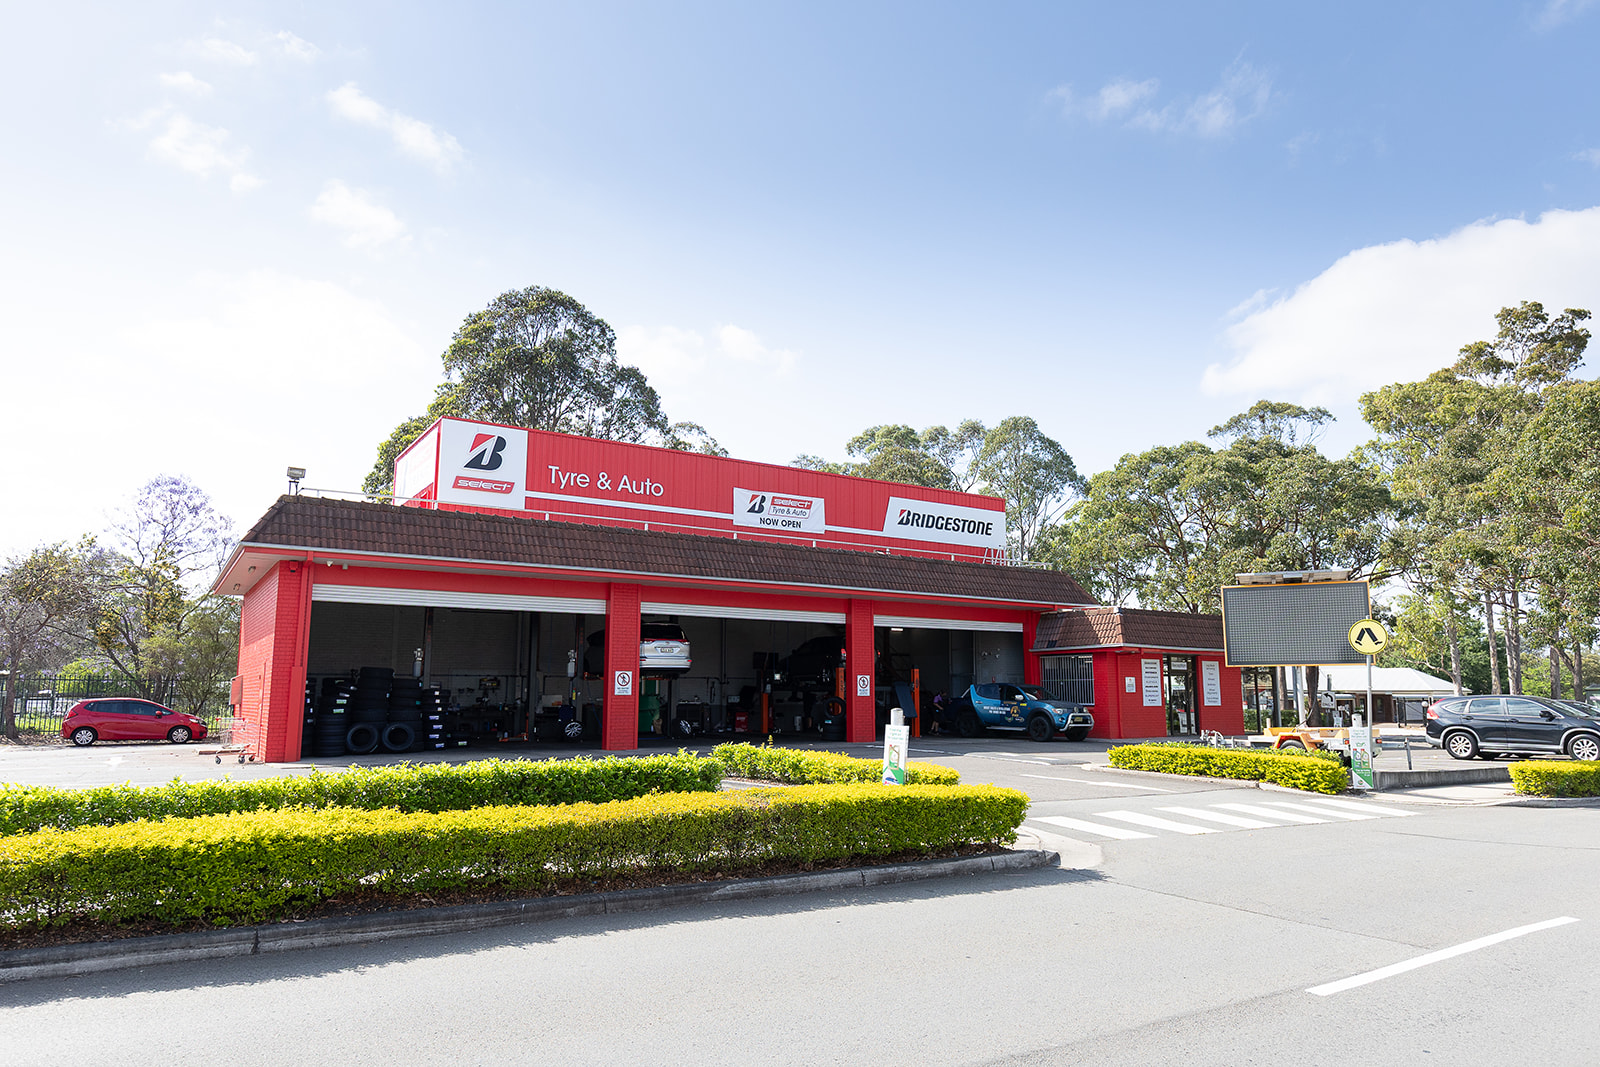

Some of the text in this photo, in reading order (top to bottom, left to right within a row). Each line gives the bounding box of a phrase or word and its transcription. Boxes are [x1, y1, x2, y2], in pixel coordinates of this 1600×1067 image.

[548, 465, 664, 497] Tyre & Auto
[760, 517, 802, 528] NOW OPEN
[897, 509, 993, 536] BRIDGESTONE
